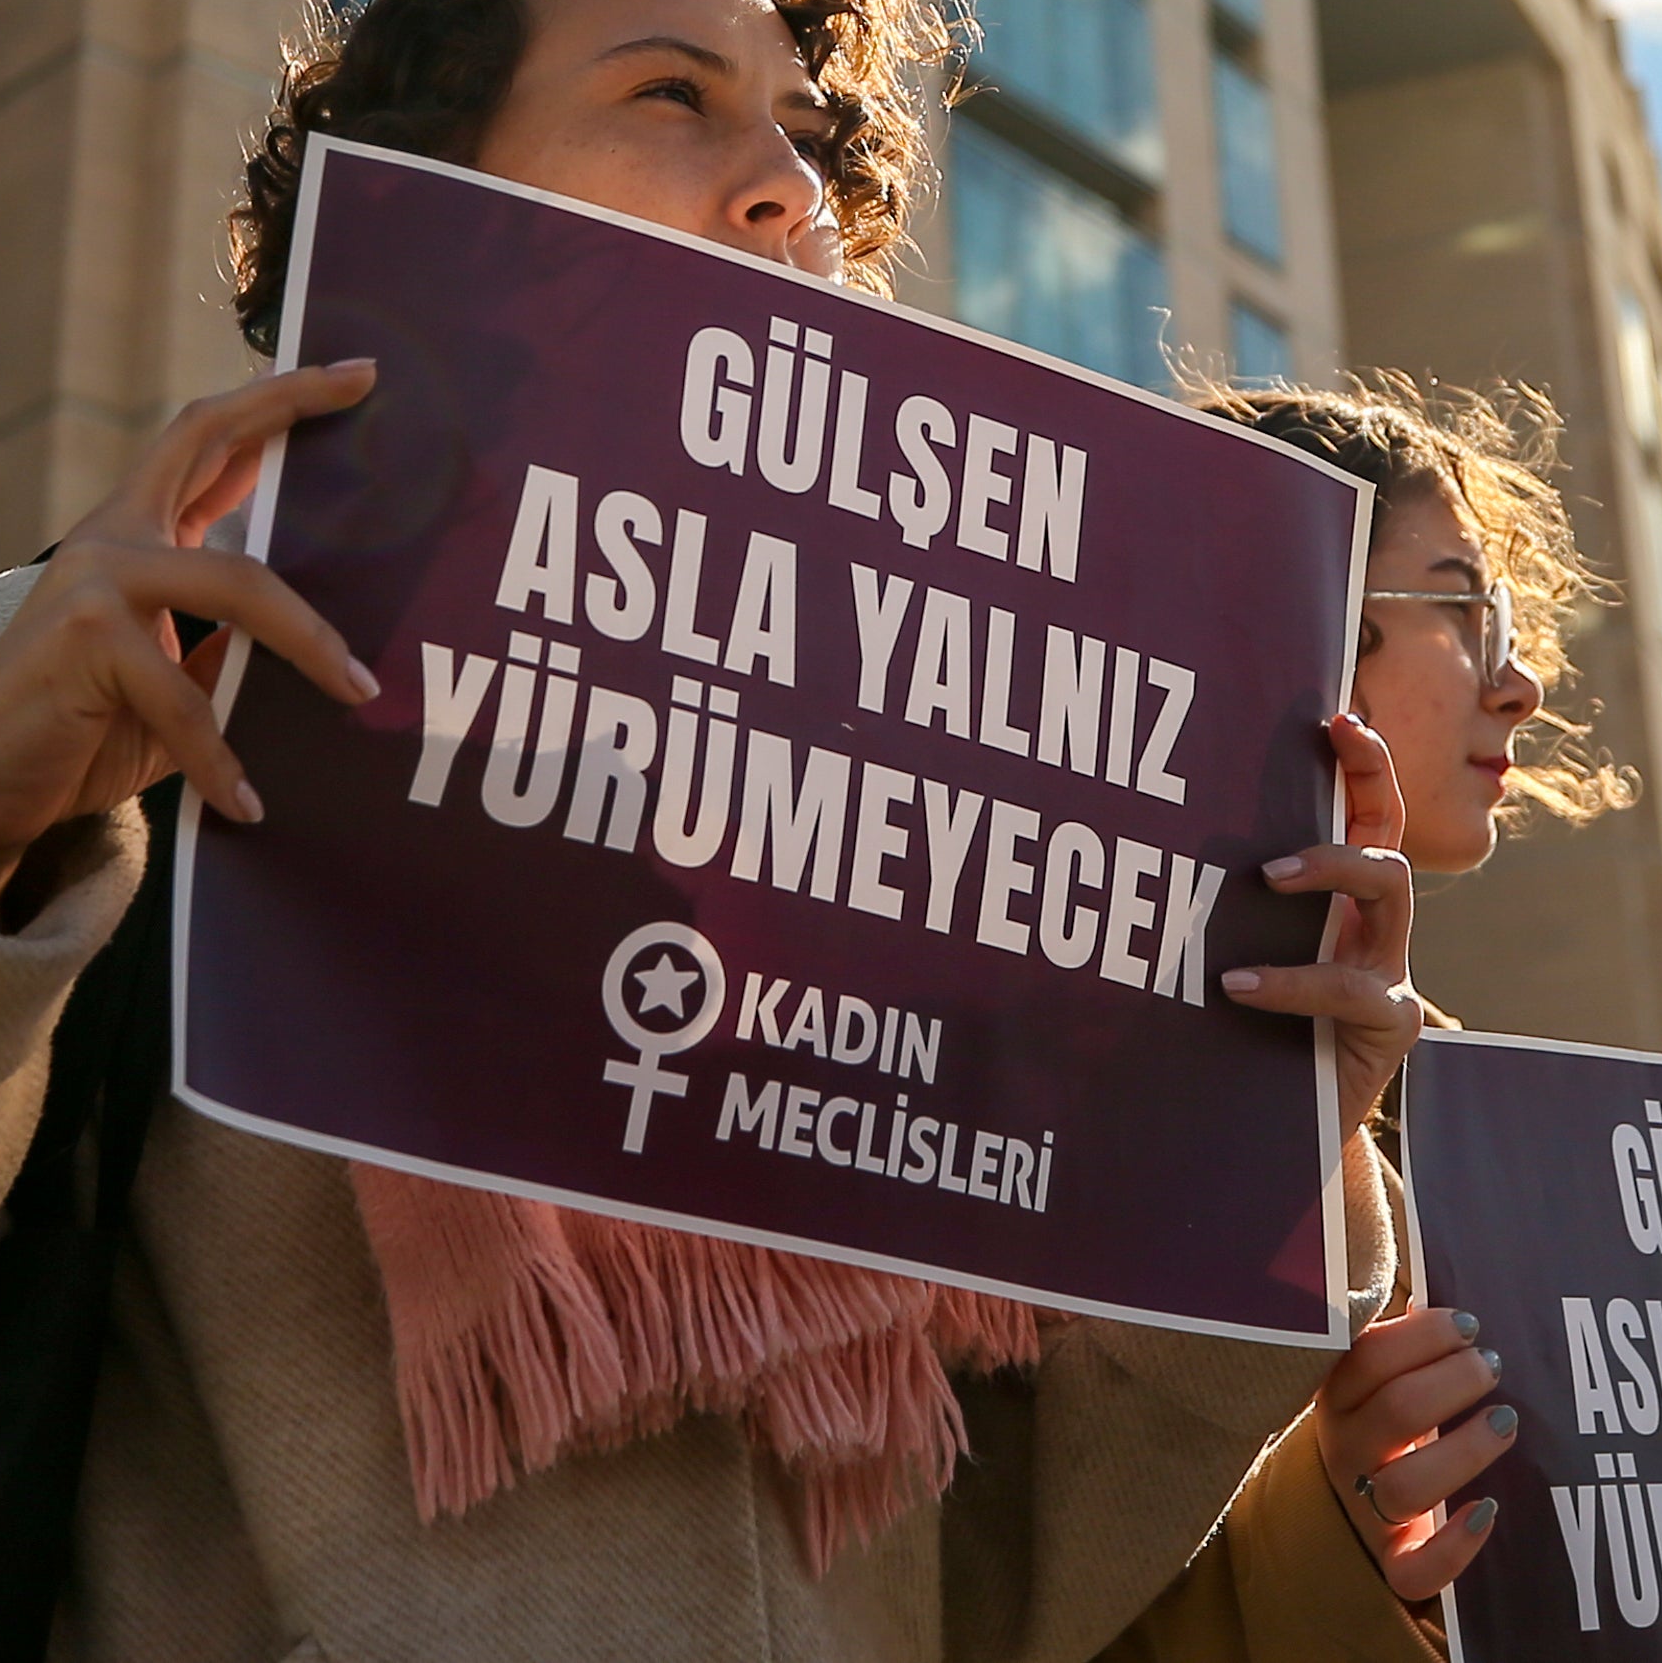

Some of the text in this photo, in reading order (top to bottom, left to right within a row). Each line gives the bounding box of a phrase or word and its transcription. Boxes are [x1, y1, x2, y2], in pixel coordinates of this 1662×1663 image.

[680, 315, 1089, 585] GÜLŞEN
[494, 463, 1197, 807] ASLA YALNIZ
[407, 630, 1227, 1009] YÜRÜMEYECEK
[714, 1072, 1054, 1214] MECLİSLERİ
[735, 970, 943, 1086] KADIN
